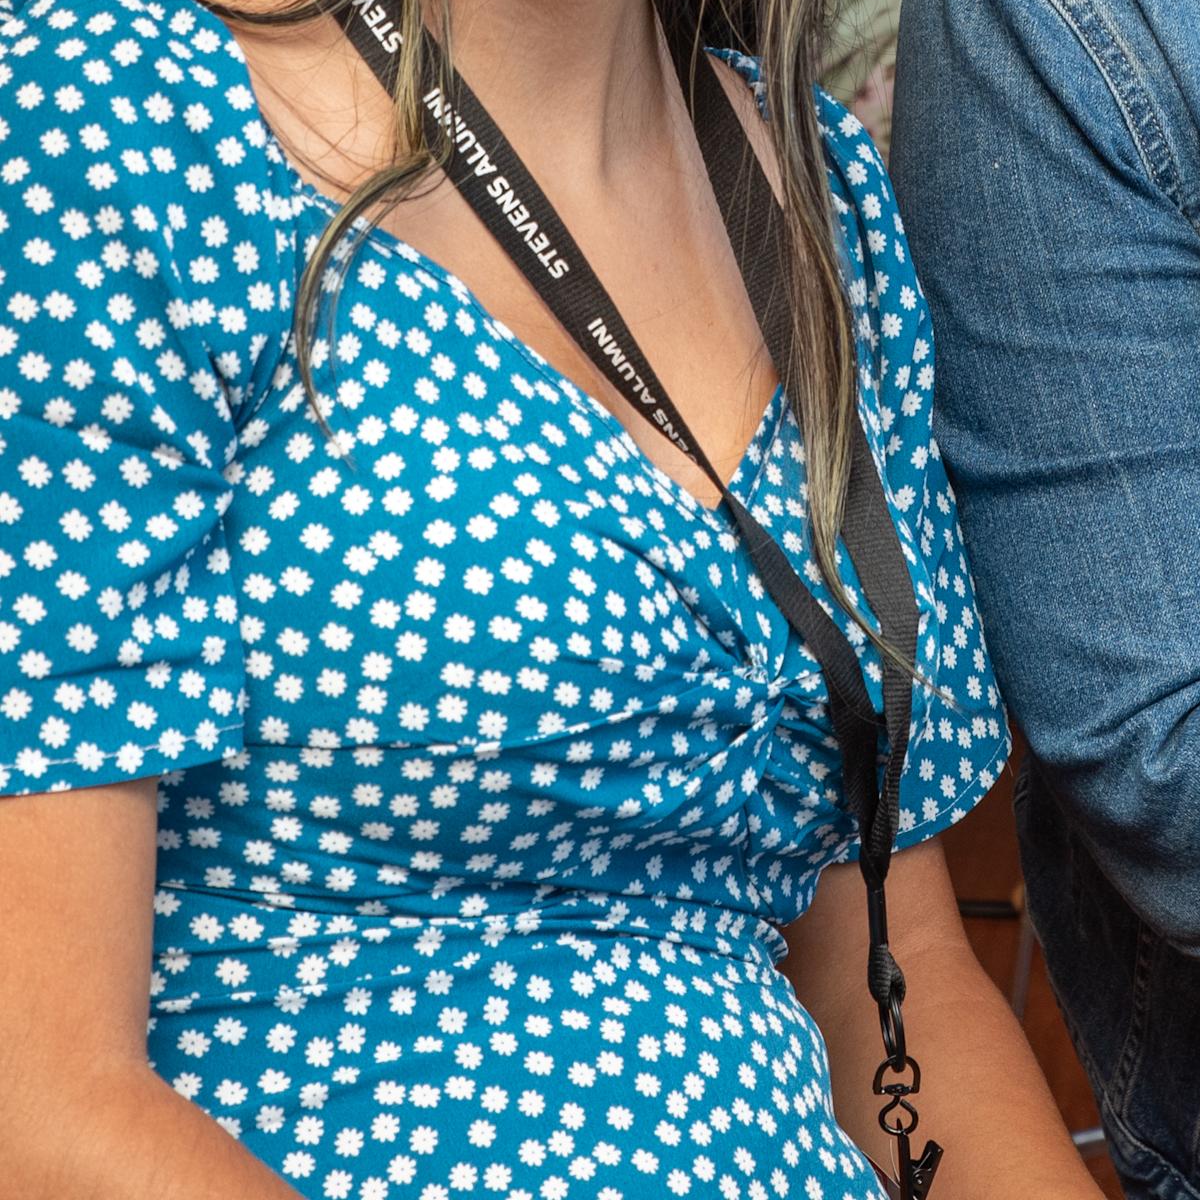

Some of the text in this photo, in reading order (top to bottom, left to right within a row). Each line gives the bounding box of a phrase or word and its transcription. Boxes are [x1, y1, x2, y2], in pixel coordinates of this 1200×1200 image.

[423, 87, 570, 279] STEVENS ALUMNI
[587, 317, 656, 404] ALUMNI
